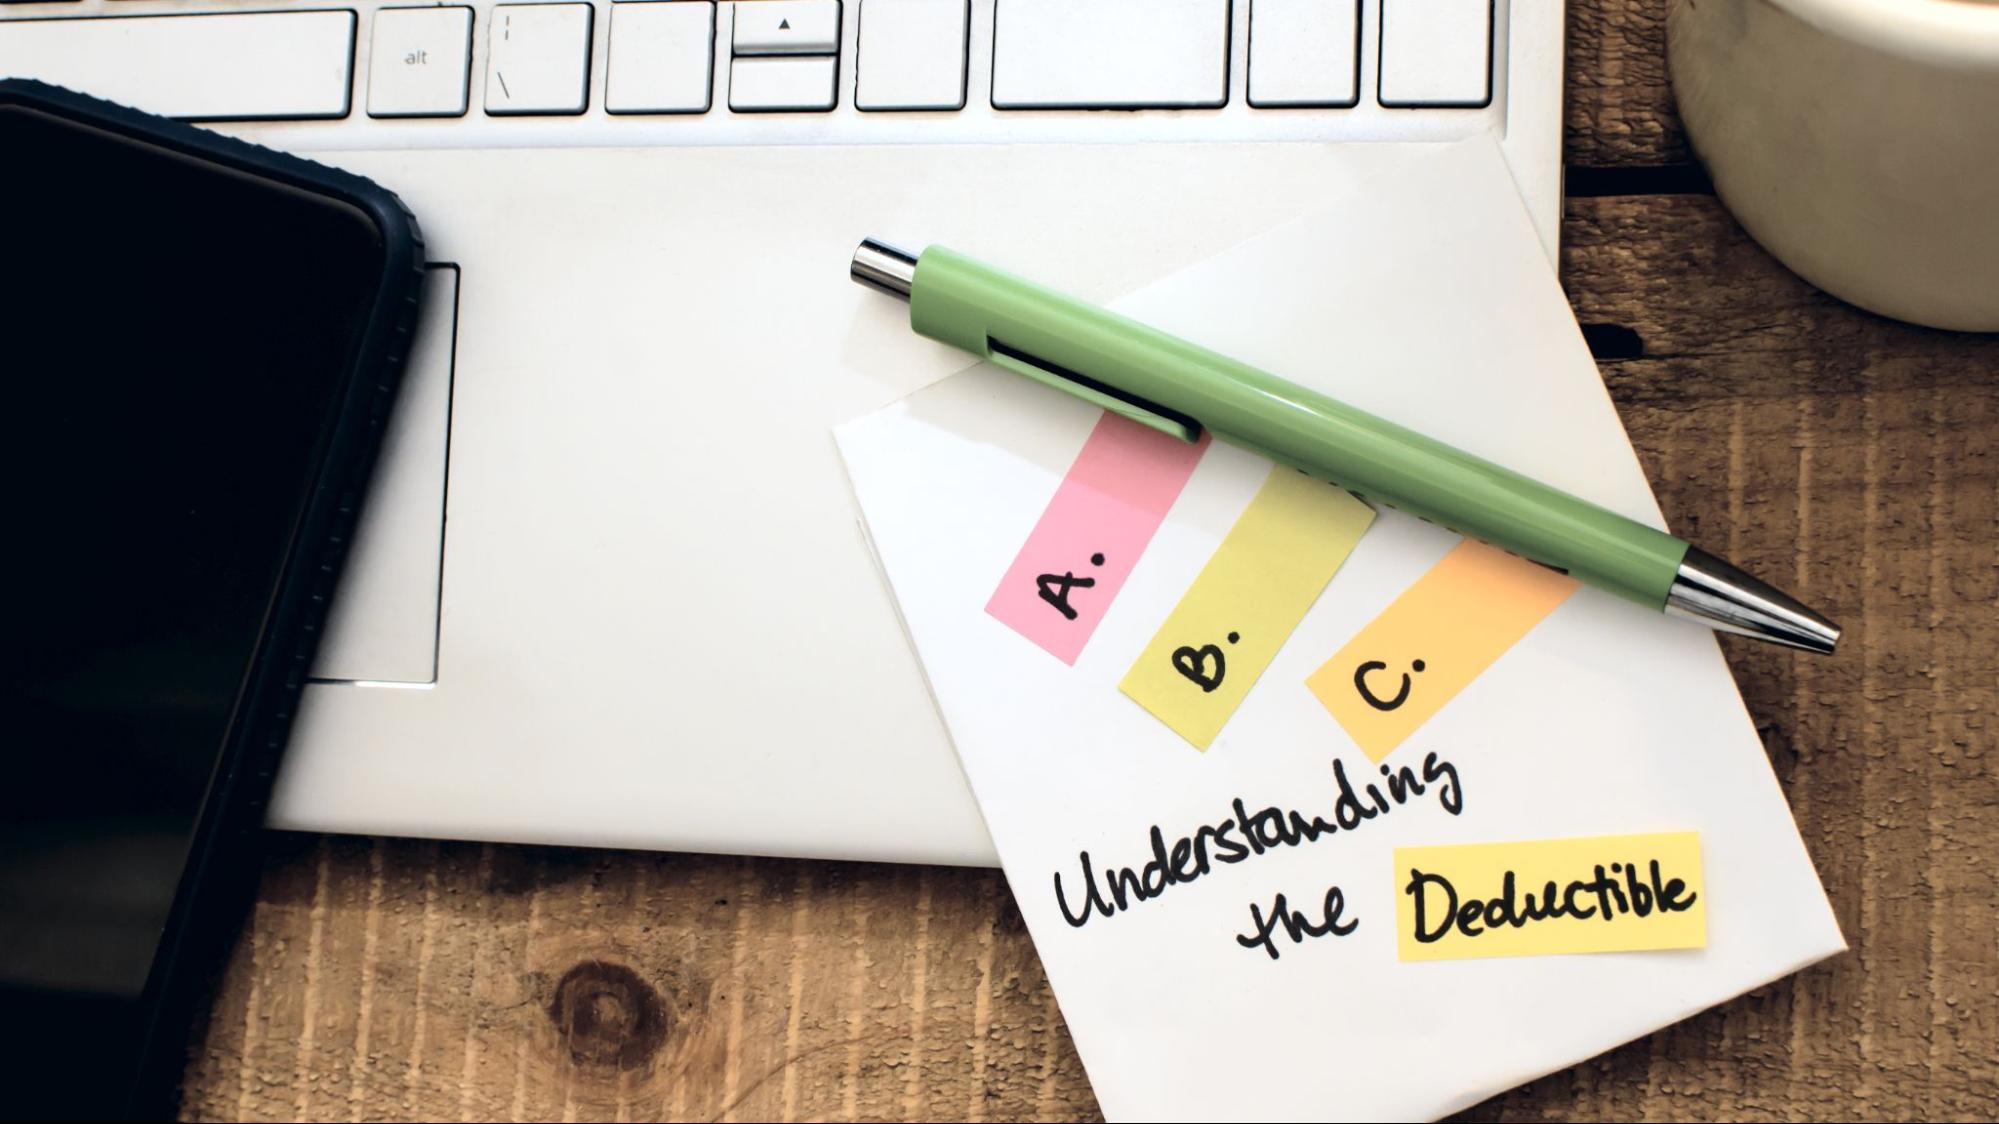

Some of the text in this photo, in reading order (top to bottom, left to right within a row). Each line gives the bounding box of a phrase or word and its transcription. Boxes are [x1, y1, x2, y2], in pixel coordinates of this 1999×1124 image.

[405, 50, 428, 65] alt
[1036, 553, 1105, 620] A.
[1171, 631, 1240, 693] B.
[1354, 659, 1426, 711] C.
[1054, 752, 1463, 928] Understanding
[1236, 859, 1697, 960] the Deductible
